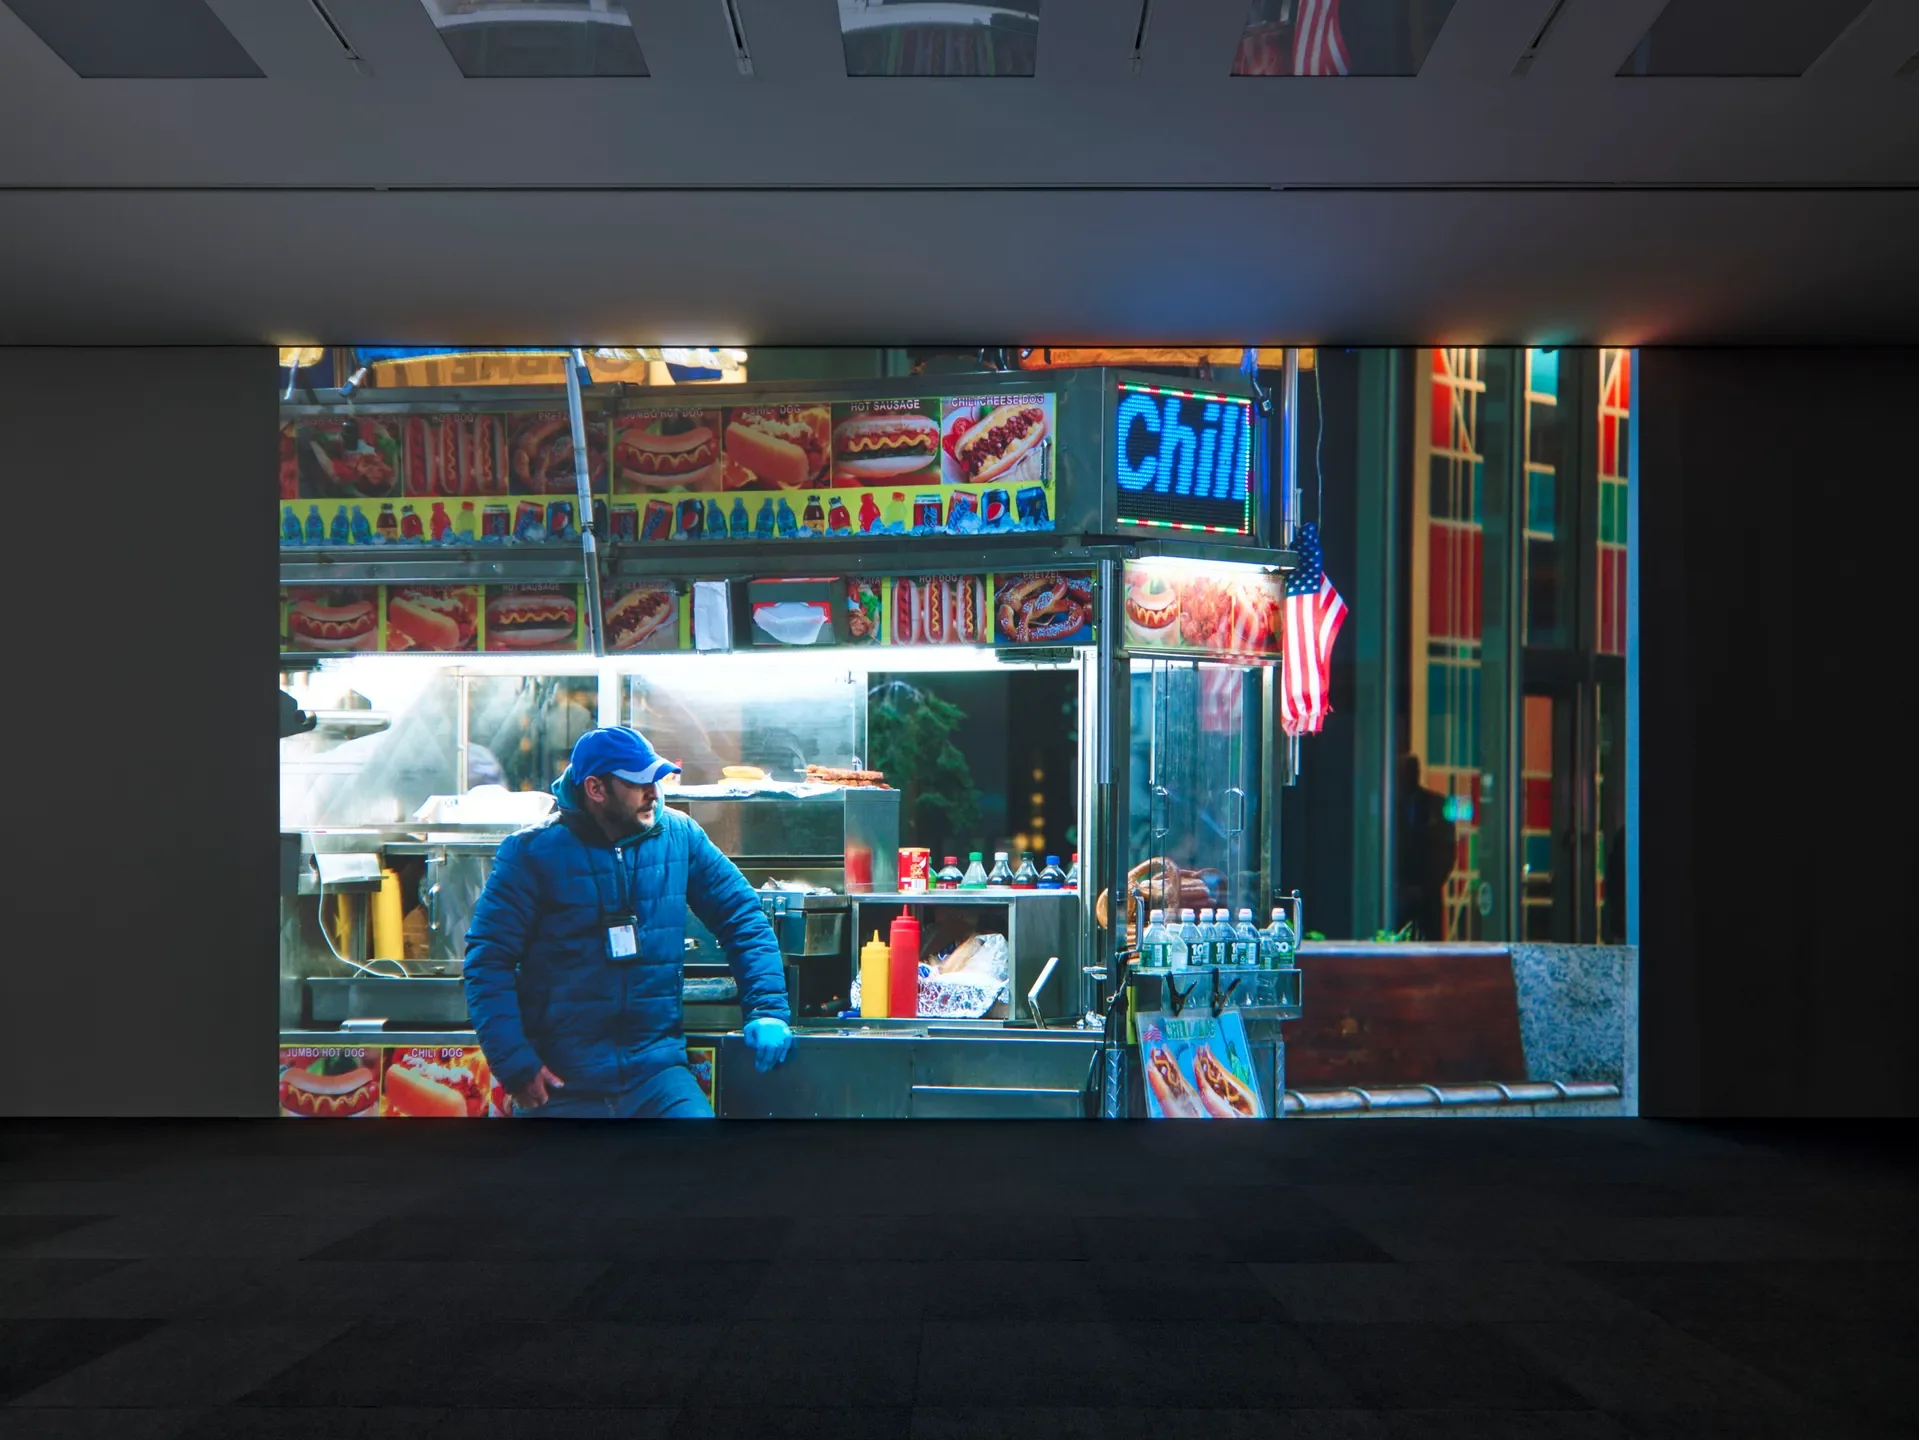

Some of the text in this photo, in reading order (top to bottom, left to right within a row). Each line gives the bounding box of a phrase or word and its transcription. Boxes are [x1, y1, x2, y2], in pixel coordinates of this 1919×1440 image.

[951, 393, 1045, 407] CHILI CHEESE DOG
[779, 403, 802, 414] DOG
[850, 399, 921, 412] HOT SAUSAGE
[659, 409, 679, 418] HOT
[919, 574, 959, 584] HOT DOG
[1023, 570, 1060, 580] PRETZEL
[521, 583, 560, 591] SAUSAGE
[286, 1048, 365, 1058] JUMBO HOT DOG
[411, 1048, 463, 1058] CHILI DOG
